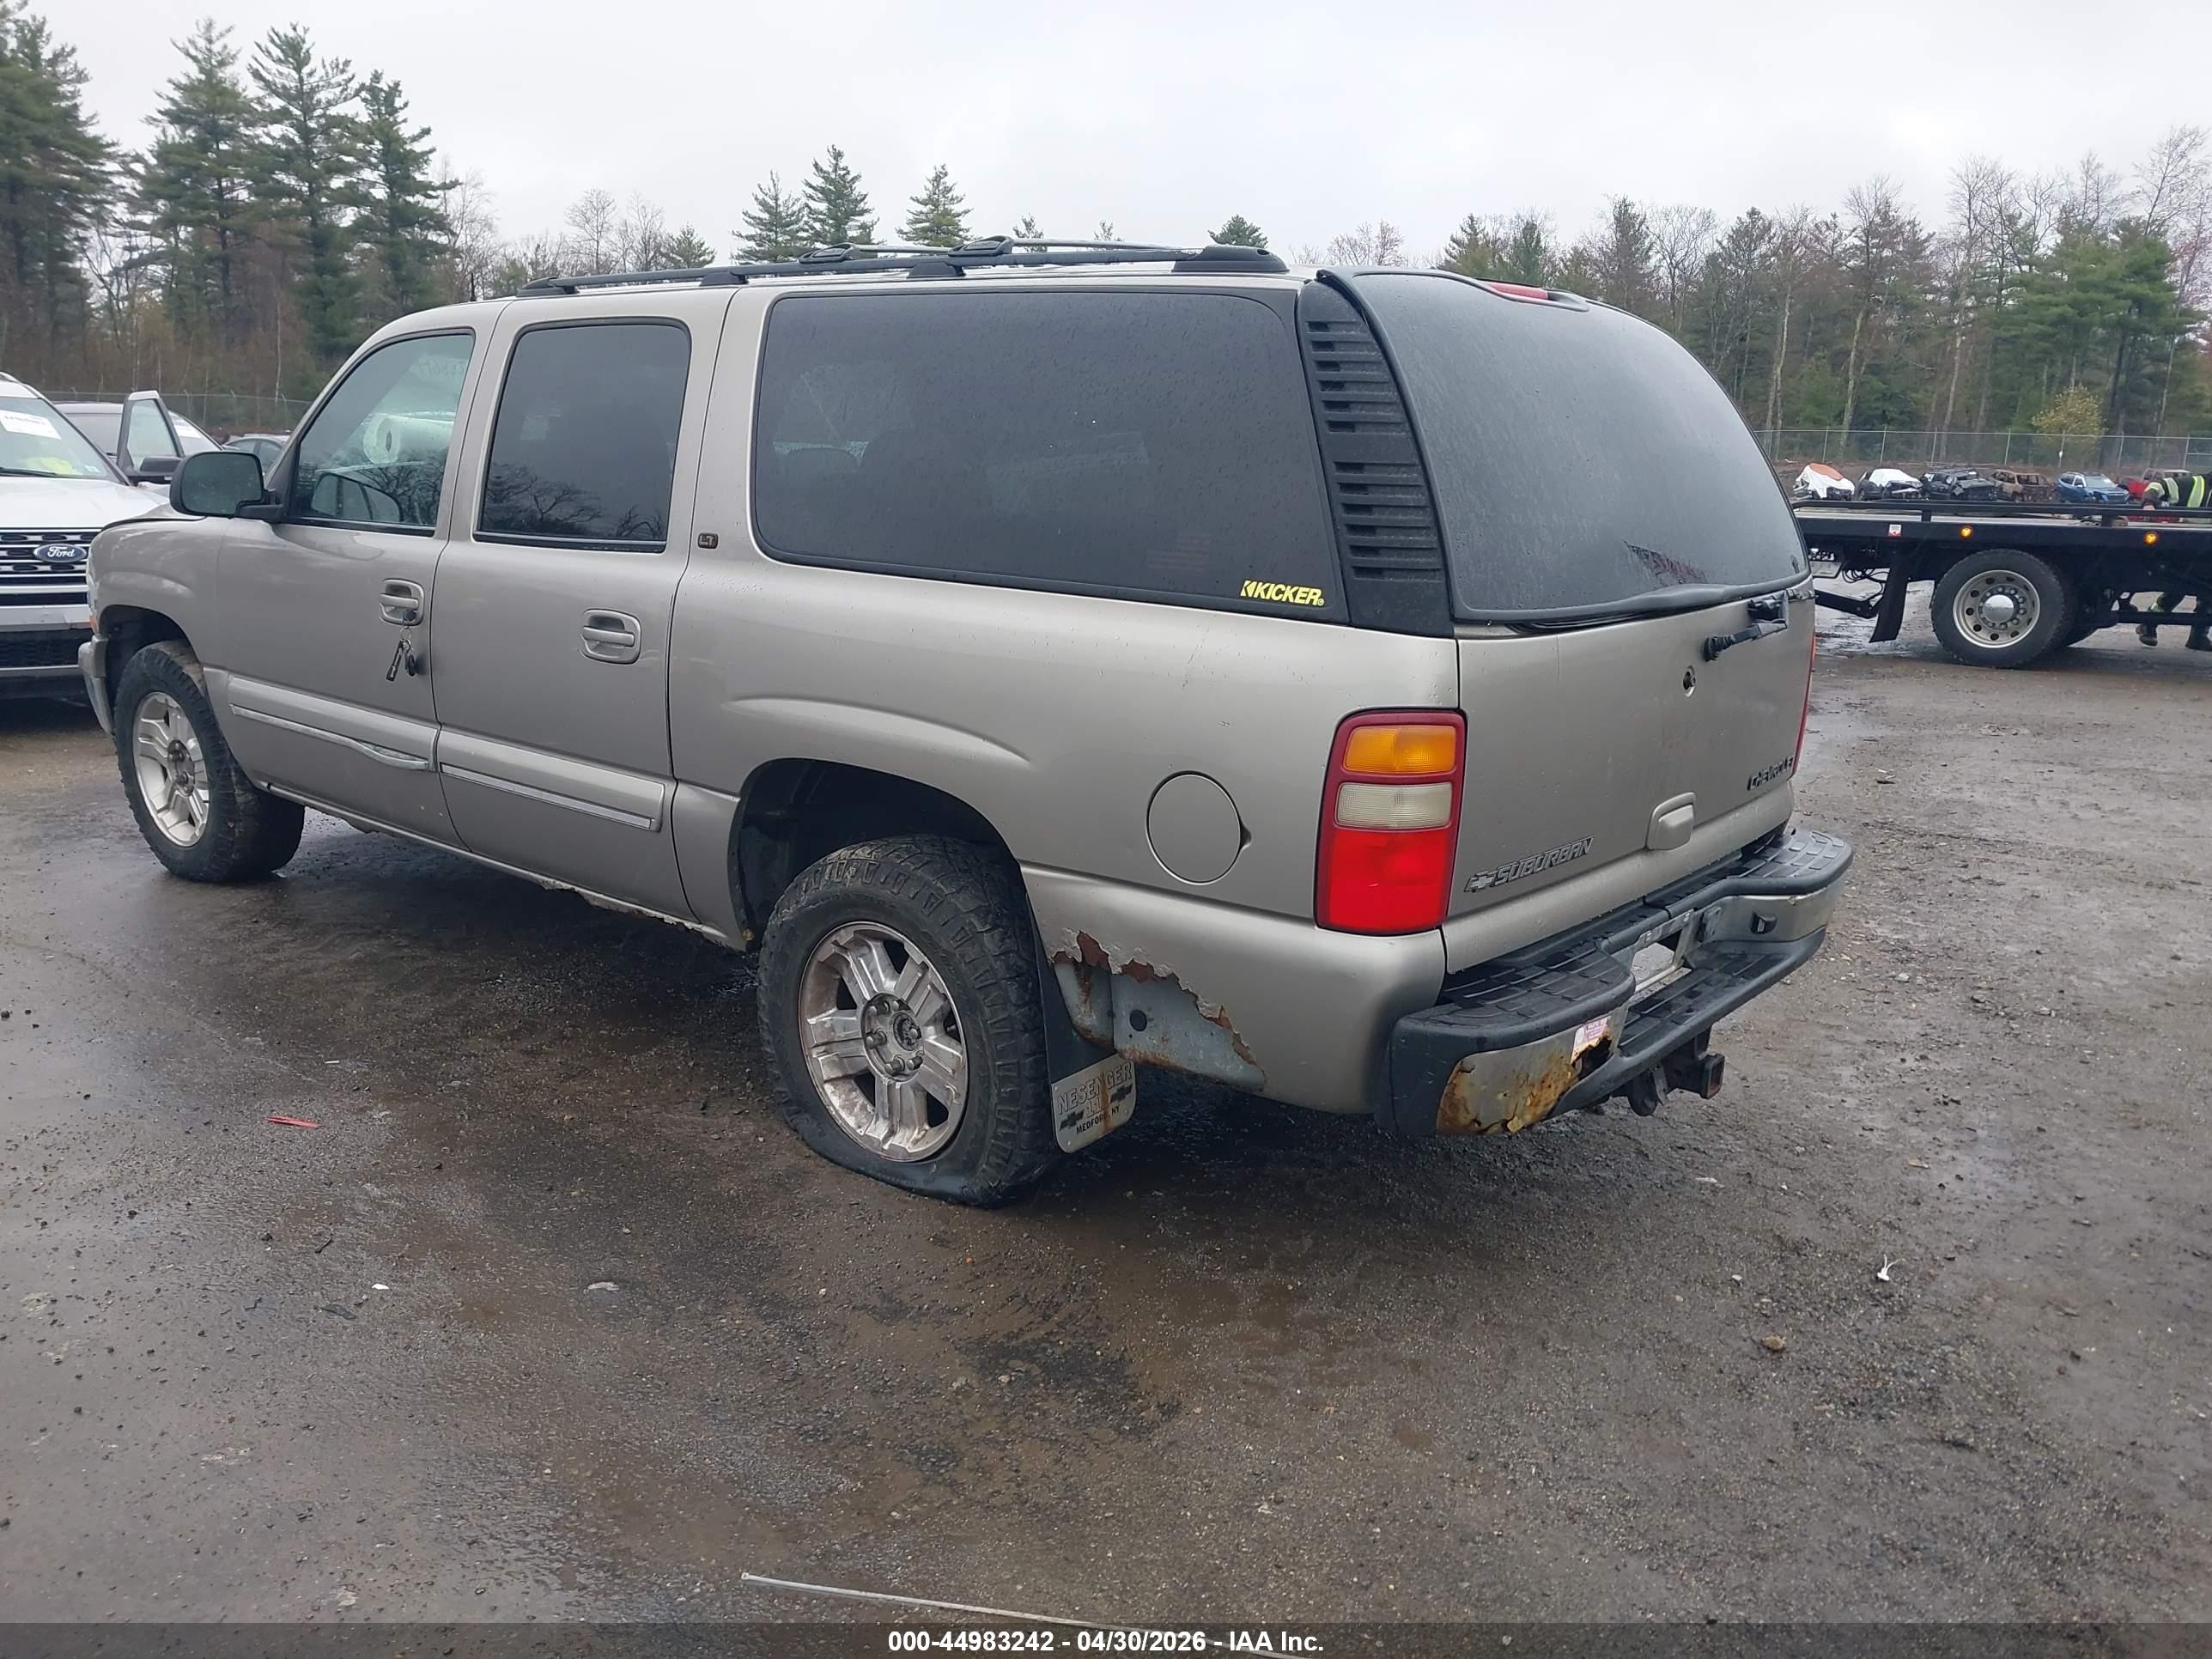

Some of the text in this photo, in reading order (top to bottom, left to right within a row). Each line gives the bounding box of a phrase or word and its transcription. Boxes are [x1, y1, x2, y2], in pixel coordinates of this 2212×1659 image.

[47, 546, 76, 557] Ford
[1747, 757, 1794, 791] CHEVROLE
[1494, 836, 1594, 886] SUBURBAN
[1058, 1061, 1133, 1115] NESENGER
[1111, 1104, 1121, 1116] NY
